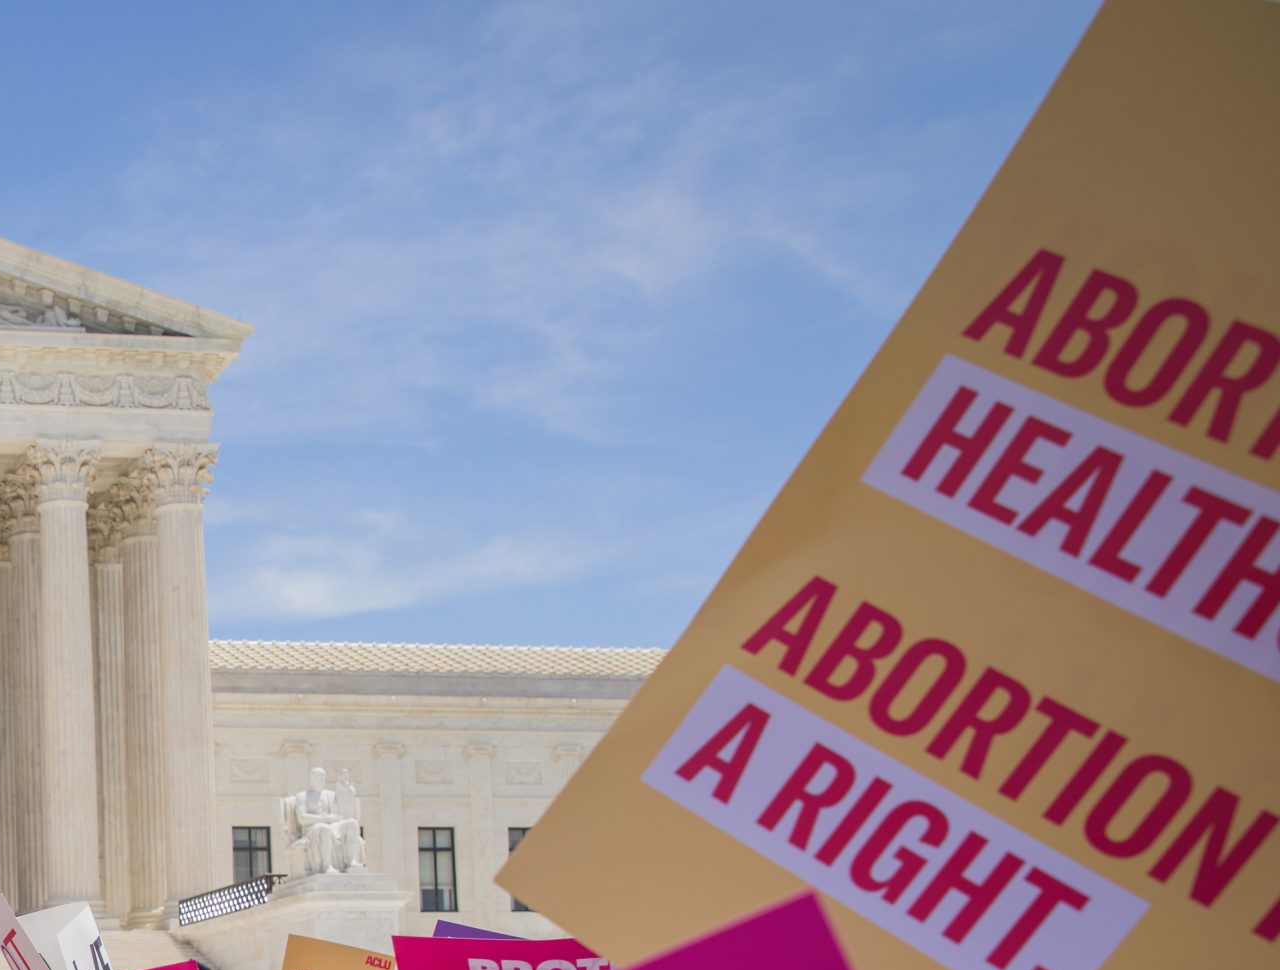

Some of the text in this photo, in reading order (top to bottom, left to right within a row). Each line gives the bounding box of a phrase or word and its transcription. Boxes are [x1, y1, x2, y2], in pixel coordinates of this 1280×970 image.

[901, 384, 1280, 658] HEALTH
[674, 703, 772, 805] A
[740, 575, 1280, 908] ABORTION
[365, 955, 392, 970] ACLU
